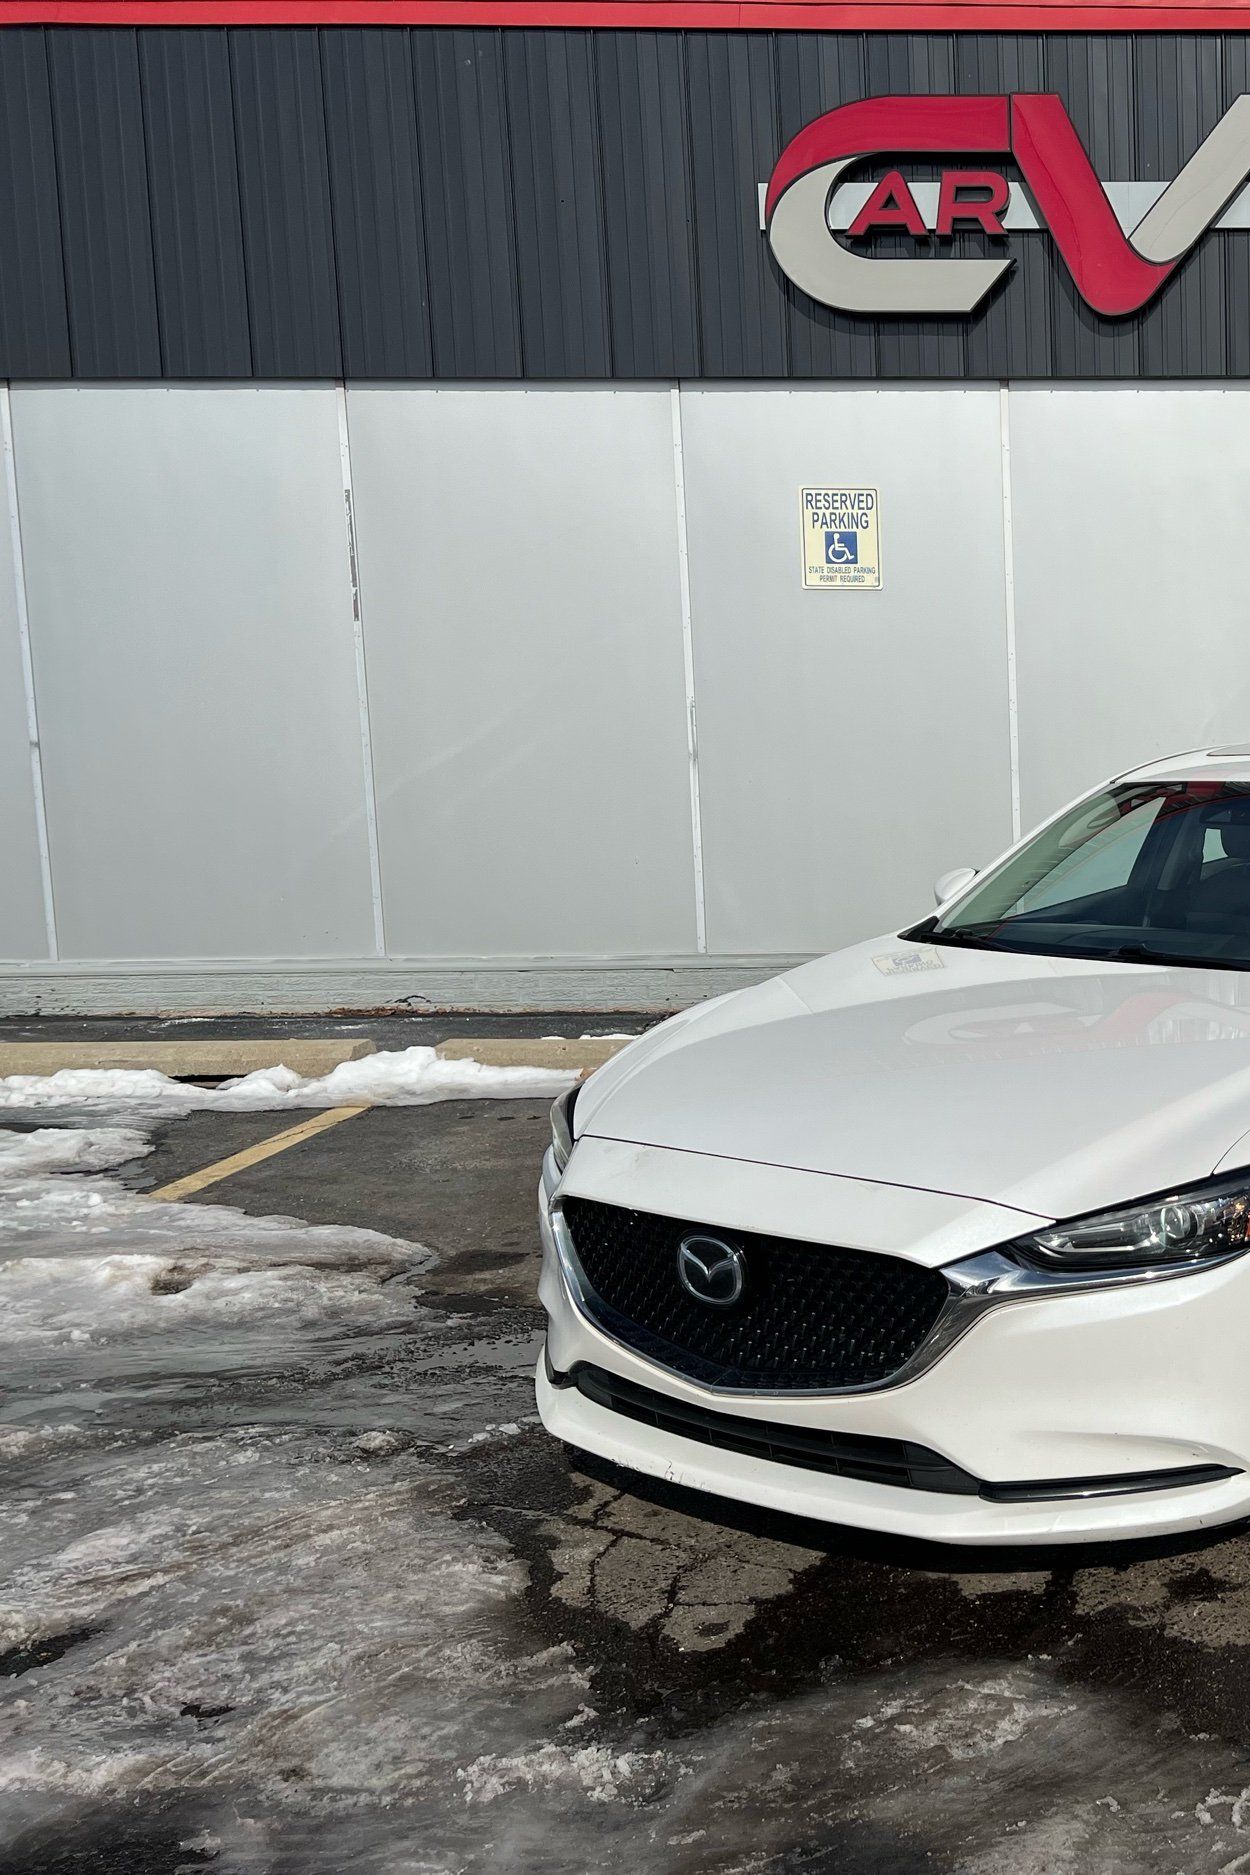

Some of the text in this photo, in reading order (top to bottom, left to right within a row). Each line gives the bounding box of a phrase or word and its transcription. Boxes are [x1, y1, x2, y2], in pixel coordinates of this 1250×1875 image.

[805, 492, 874, 511] RESERVED
[811, 511, 869, 530] PARKING
[808, 566, 876, 575] STATE DISABLED PARKING
[840, 575, 865, 583] REQUIRED
